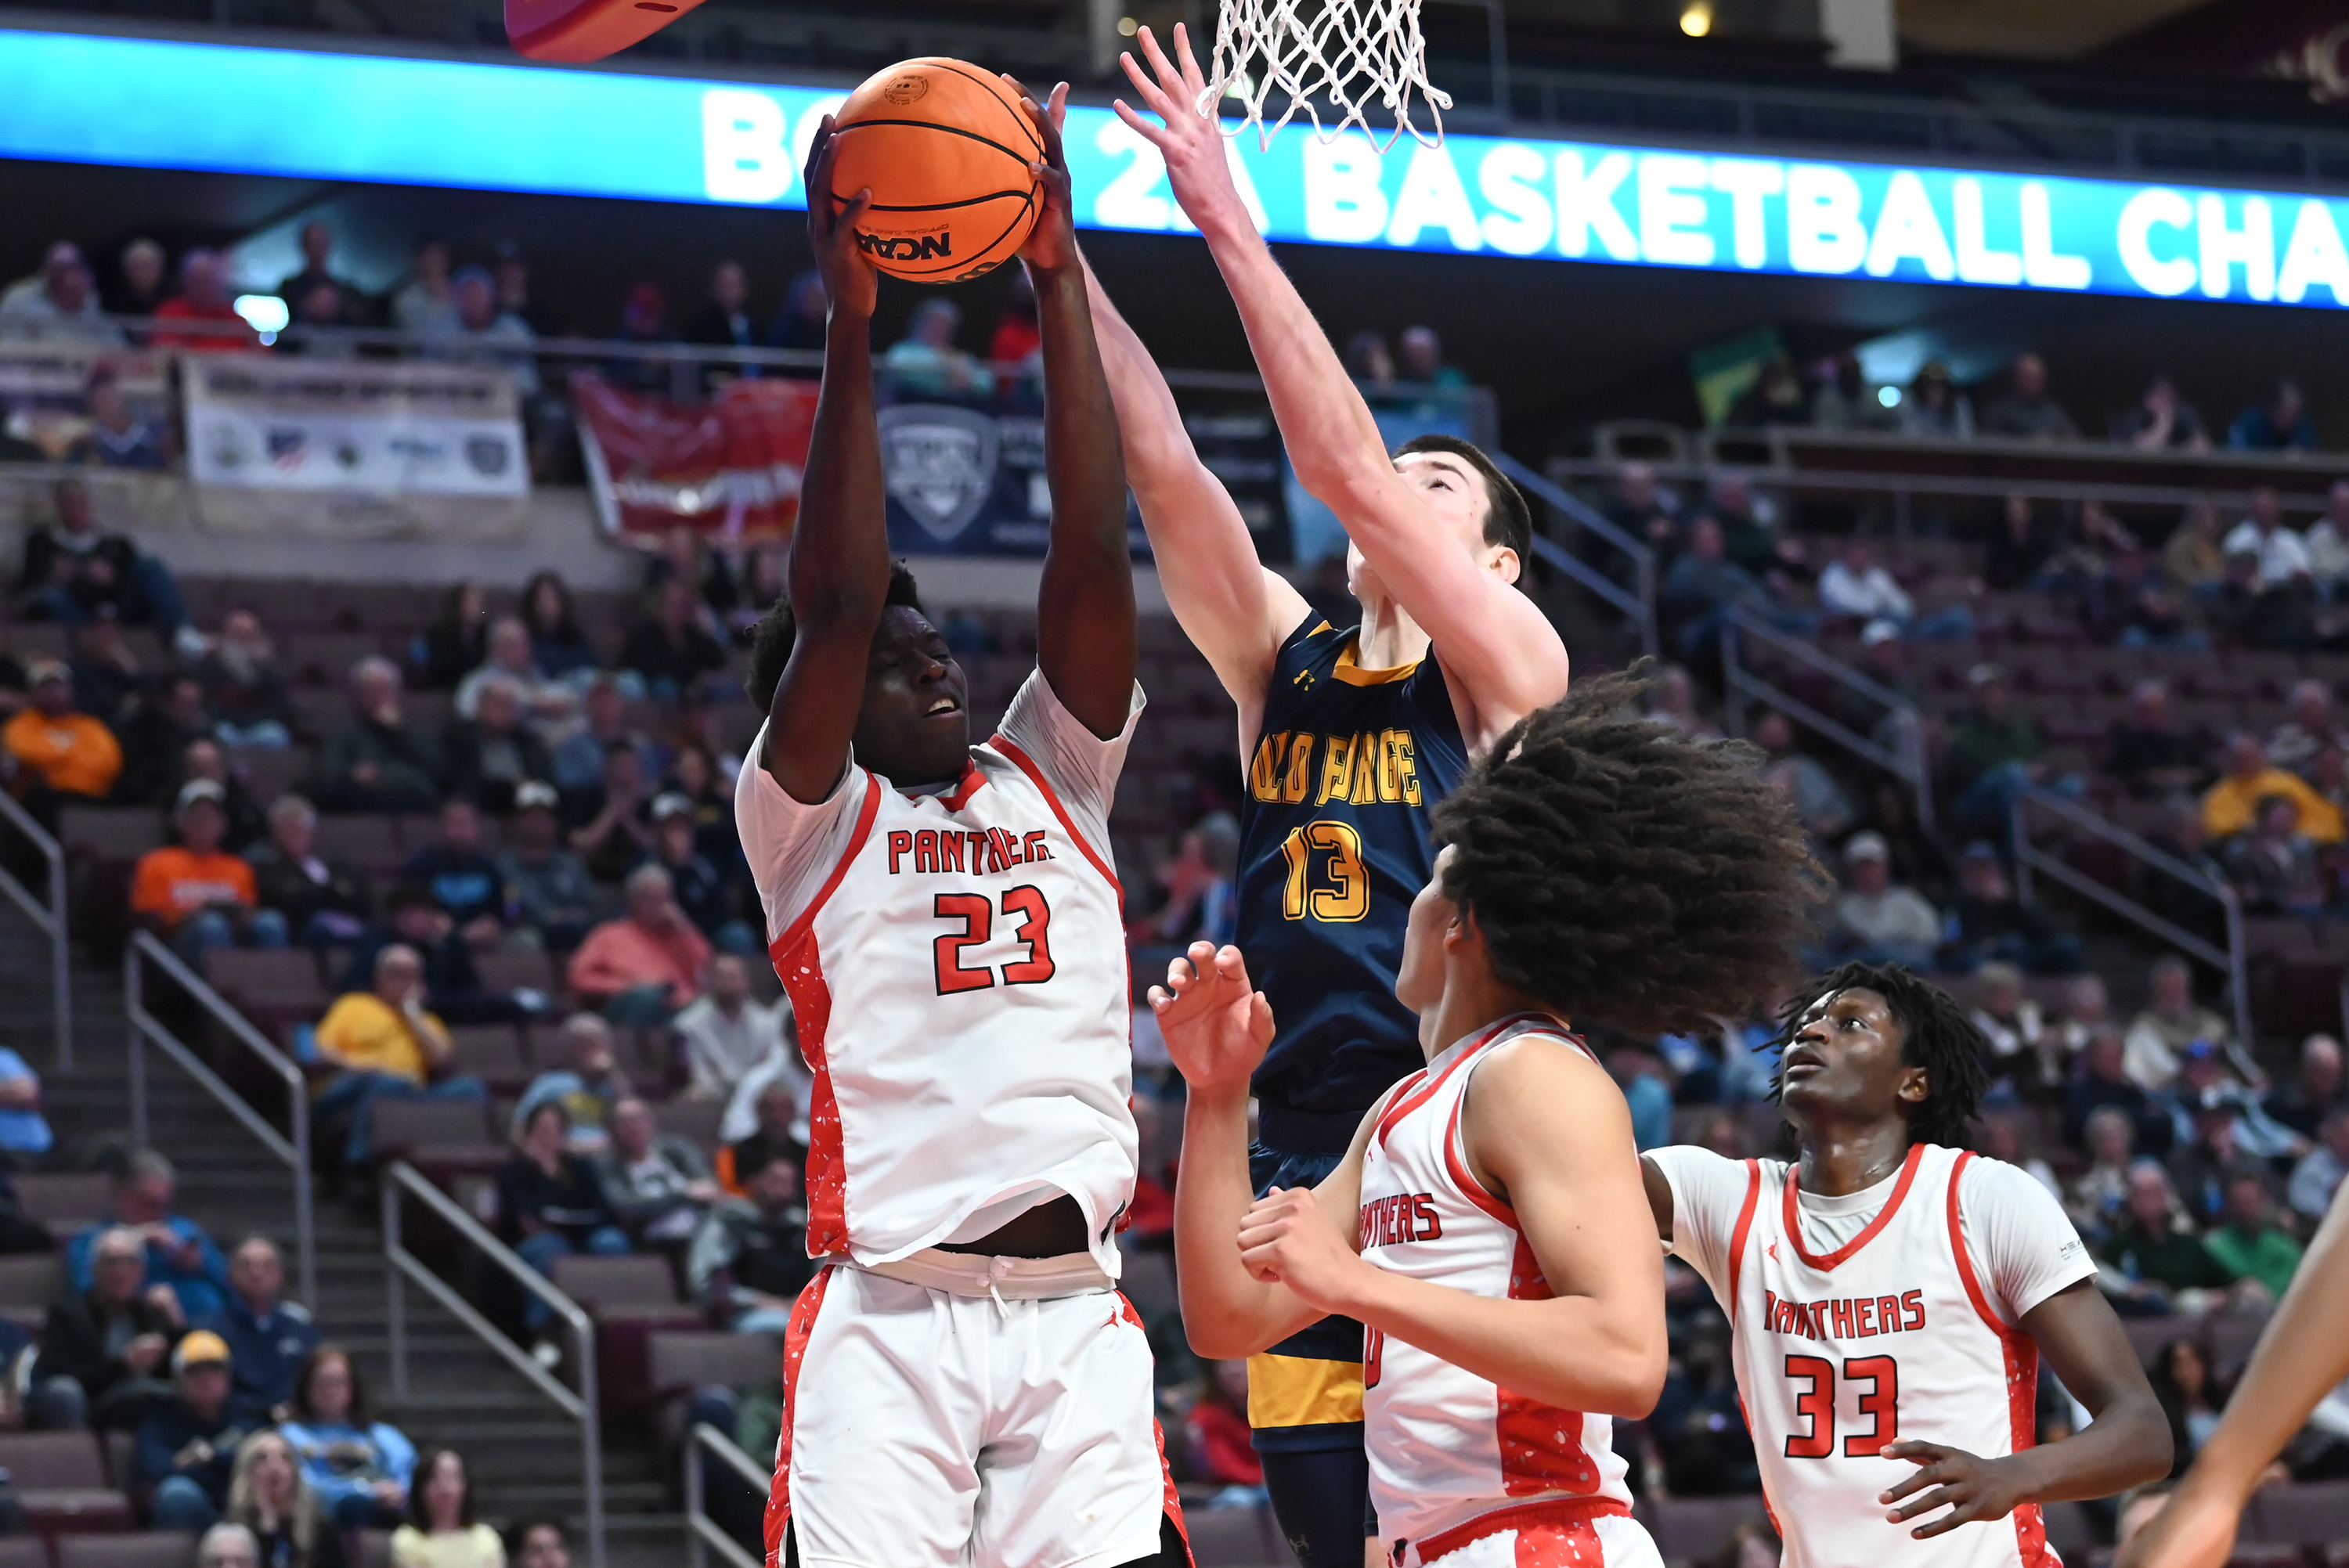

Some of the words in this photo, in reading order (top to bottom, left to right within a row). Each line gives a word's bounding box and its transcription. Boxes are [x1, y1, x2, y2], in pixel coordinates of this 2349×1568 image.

[1303, 128, 2091, 290] BASKETBALL
[2117, 186, 2349, 308] CHA
[1281, 820, 1369, 922] 13
[933, 884, 1055, 997] 23
[1764, 1289, 1925, 1341] PANTHERS
[1784, 1354, 1899, 1458] 33
